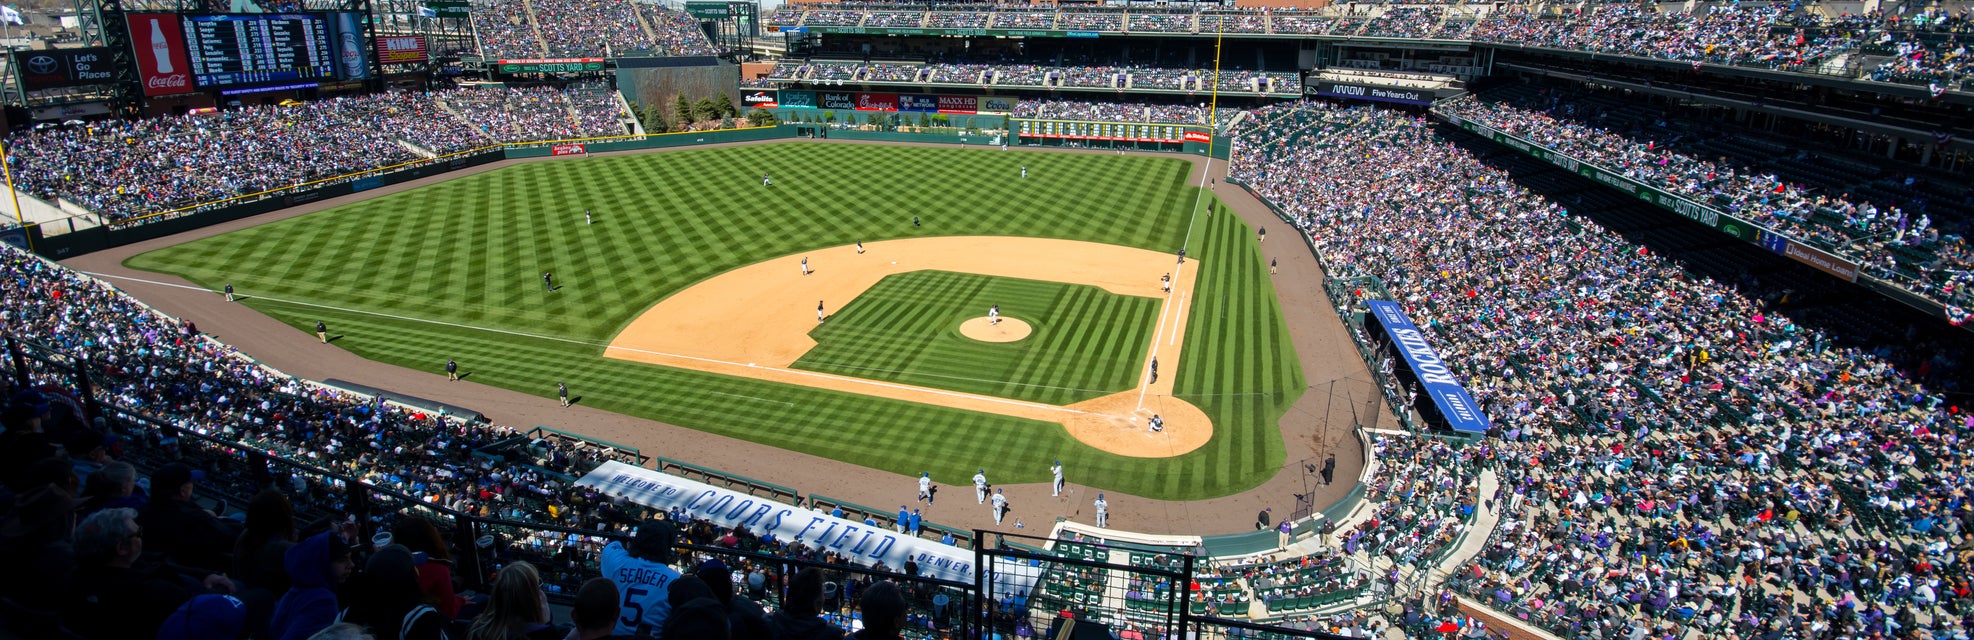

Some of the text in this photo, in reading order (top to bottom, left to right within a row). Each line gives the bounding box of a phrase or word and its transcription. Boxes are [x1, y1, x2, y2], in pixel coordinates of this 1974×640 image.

[386, 38, 418, 50] KING
[75, 54, 97, 62] Let's
[539, 64, 565, 72] SCOTTS
[79, 71, 111, 79] Places
[826, 101, 854, 109] Colorado
[985, 100, 1010, 110] Coors
[1387, 90, 1404, 99] Years
[1667, 198, 1671, 207] IS
[1674, 199, 1700, 220] SCOTTS
[1700, 208, 1718, 227] YARD
[1794, 248, 1853, 278] Ideal Home Loans
[1392, 328, 1459, 386] ROCKIES
[1446, 394, 1474, 420] COLORADO
[612, 474, 676, 496] WELCOME TO
[687, 490, 896, 559] COORS FIELD
[918, 553, 1000, 581] DENVER, CO
[620, 568, 668, 588] SEAGER
[621, 587, 648, 627] 5
